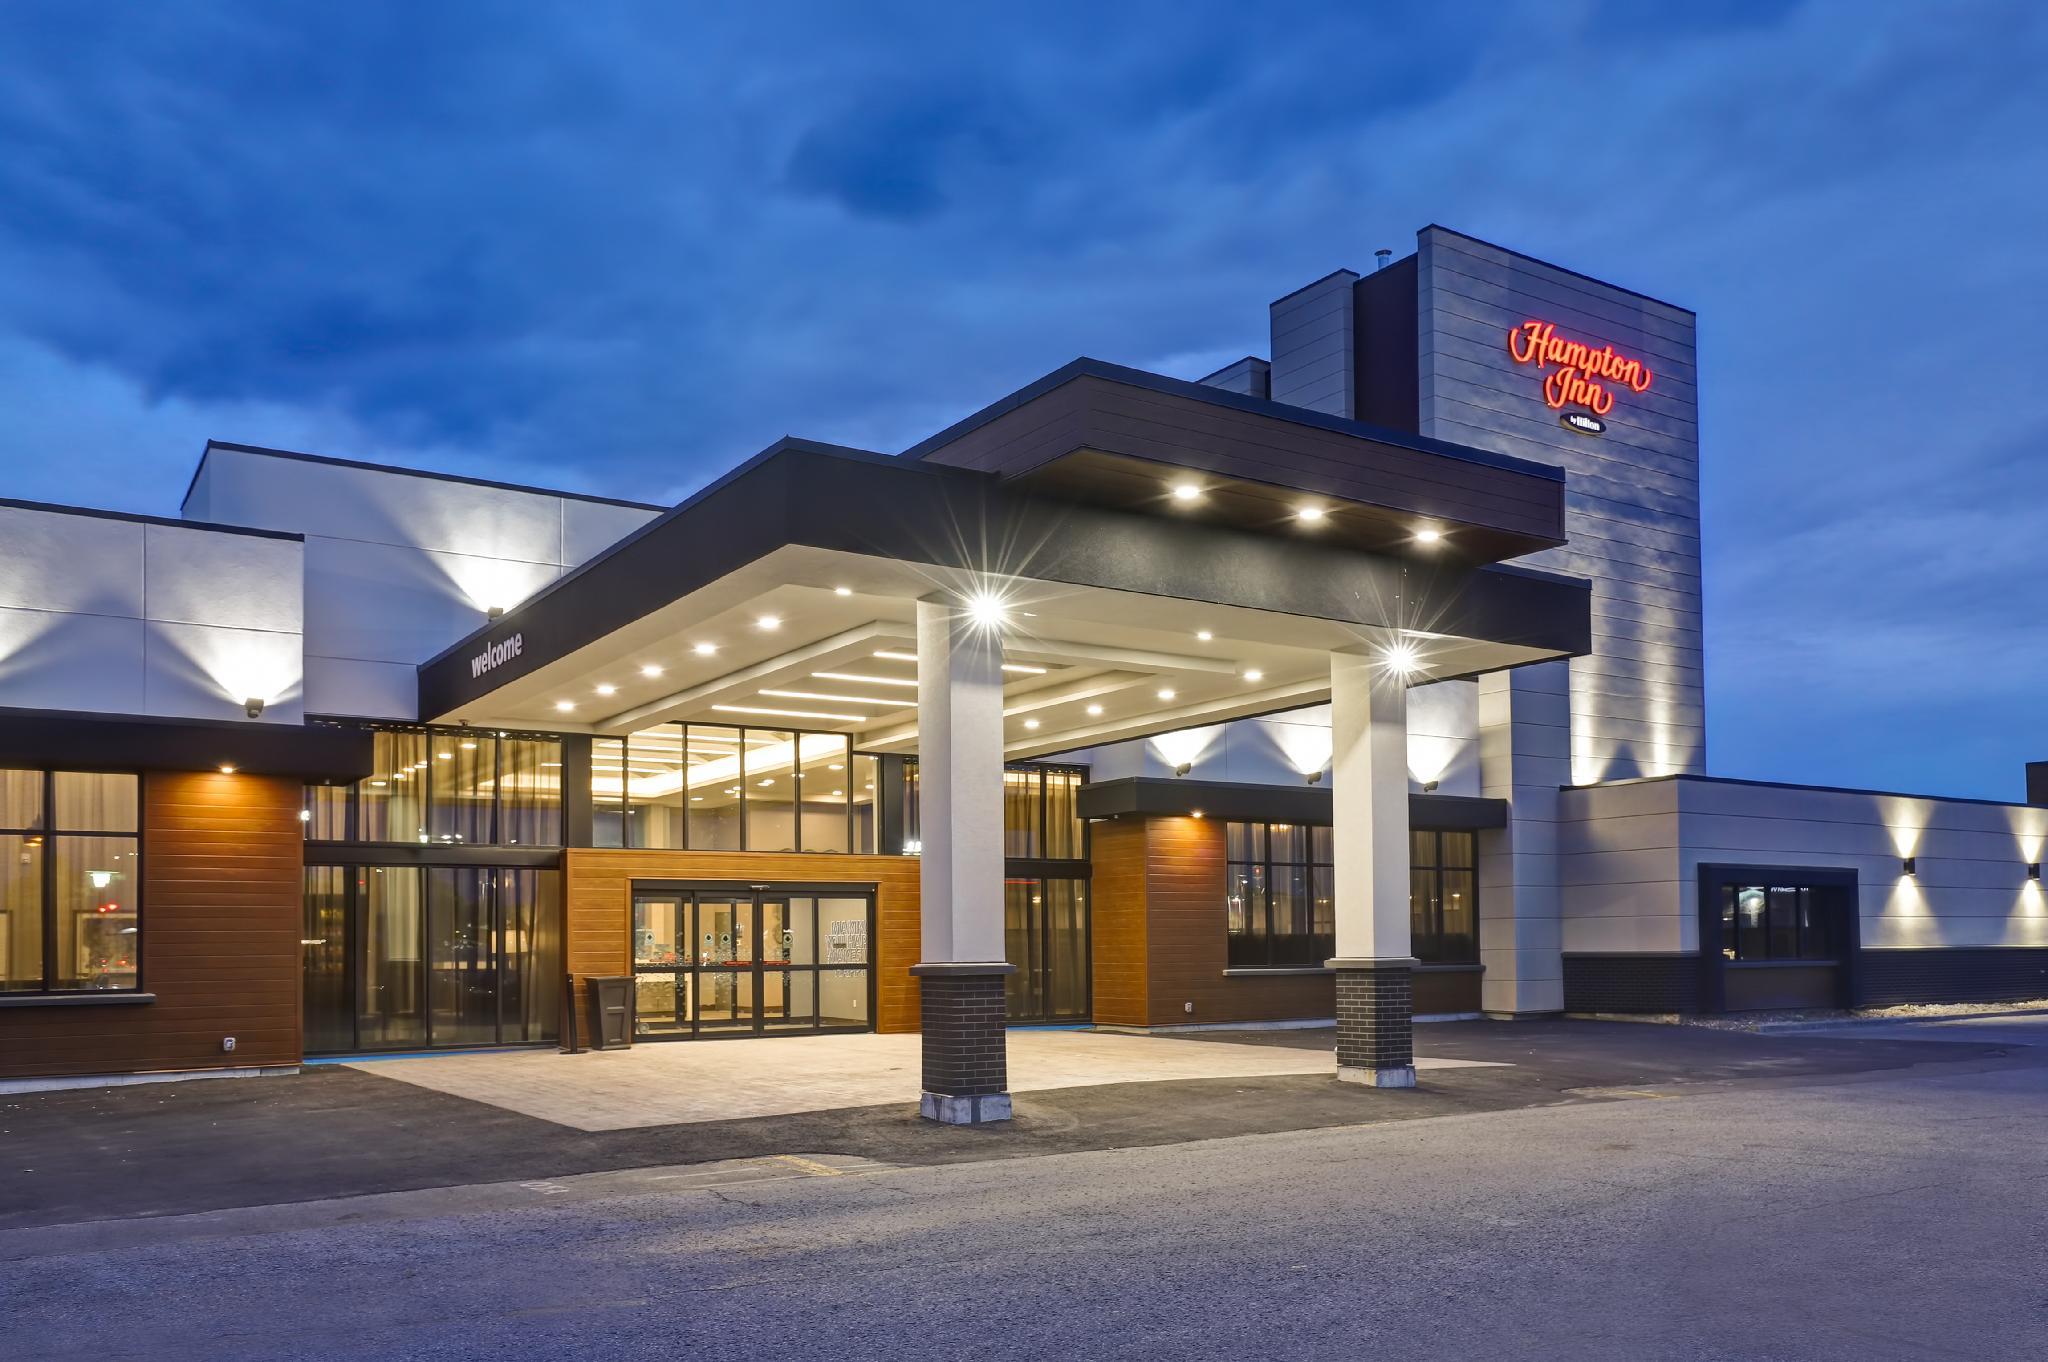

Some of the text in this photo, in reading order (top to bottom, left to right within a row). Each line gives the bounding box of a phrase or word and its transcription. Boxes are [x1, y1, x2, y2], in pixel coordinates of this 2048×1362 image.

[1509, 320, 1652, 391] Hampton
[1544, 366, 1613, 414] Inn
[1577, 416, 1600, 431] Hilton
[471, 632, 523, 678] welcome
